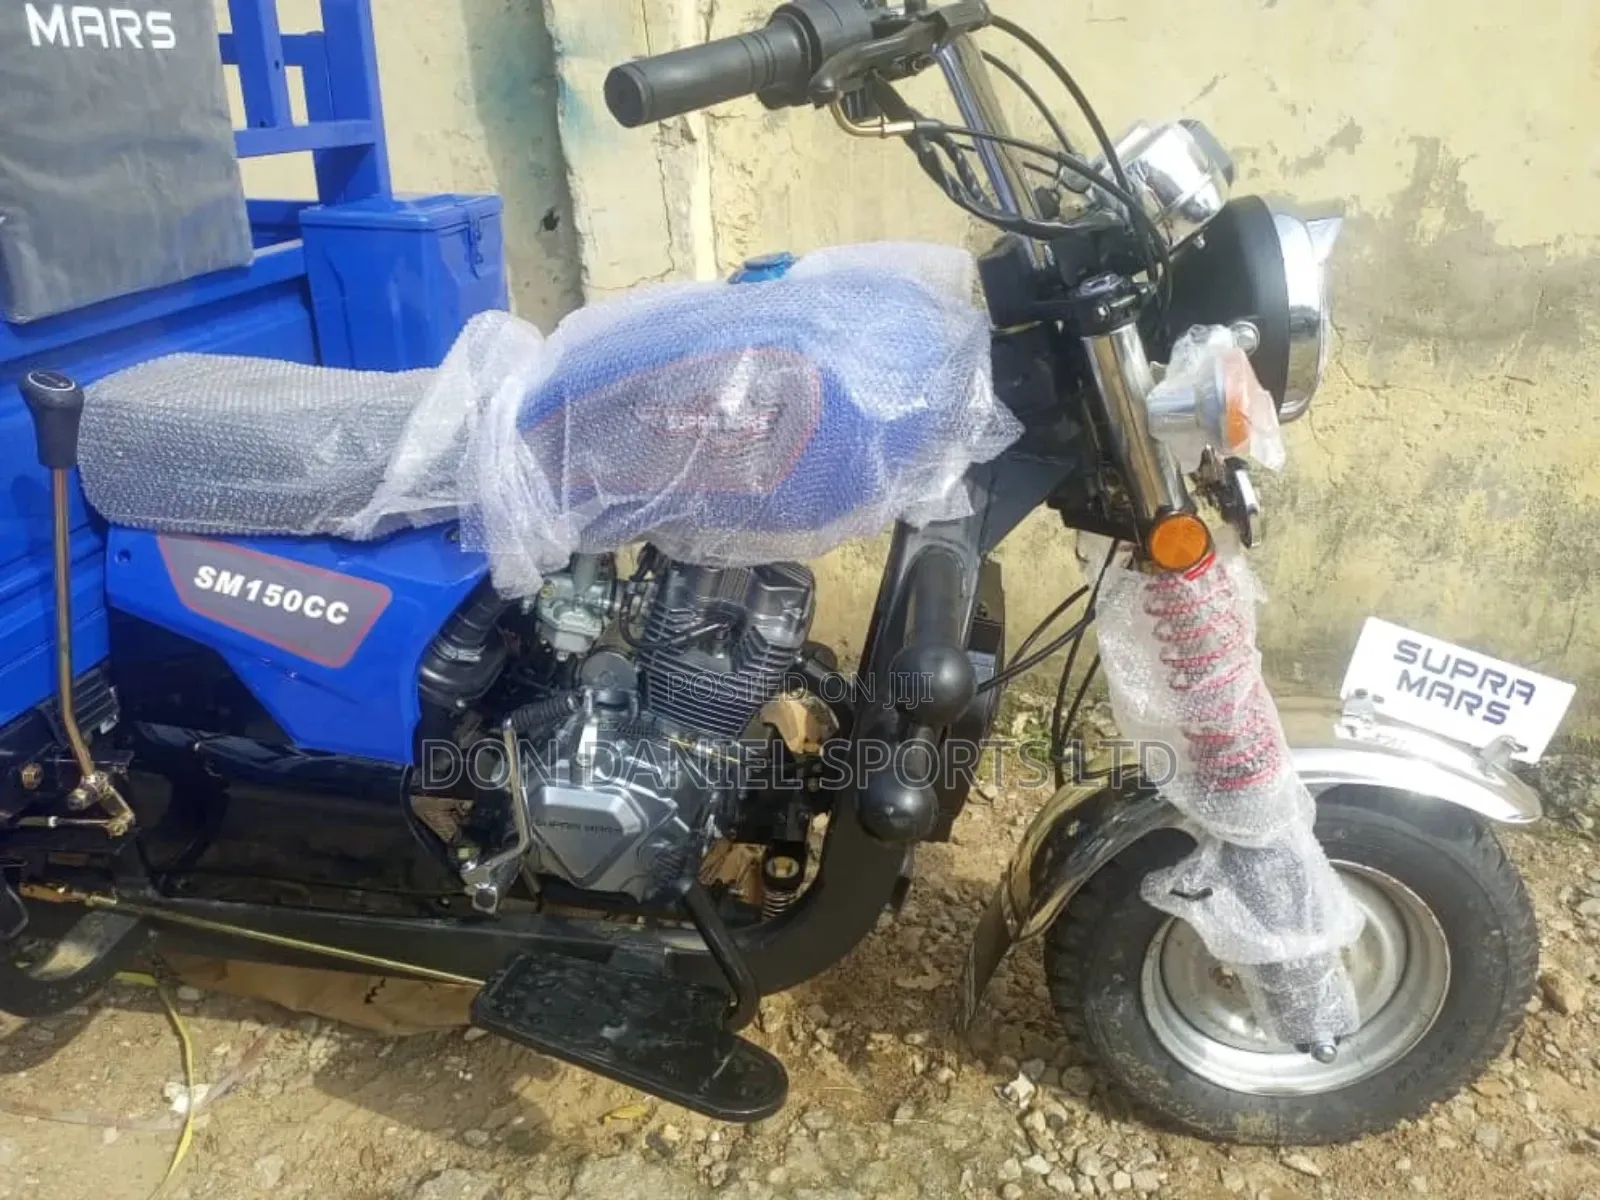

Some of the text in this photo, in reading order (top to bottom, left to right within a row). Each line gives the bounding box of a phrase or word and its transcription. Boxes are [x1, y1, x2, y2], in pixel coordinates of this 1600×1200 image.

[25, 2, 176, 49] MARS
[193, 565, 350, 625] SM150CC
[1393, 639, 1536, 706] SUPRA
[1396, 669, 1511, 725] MARS
